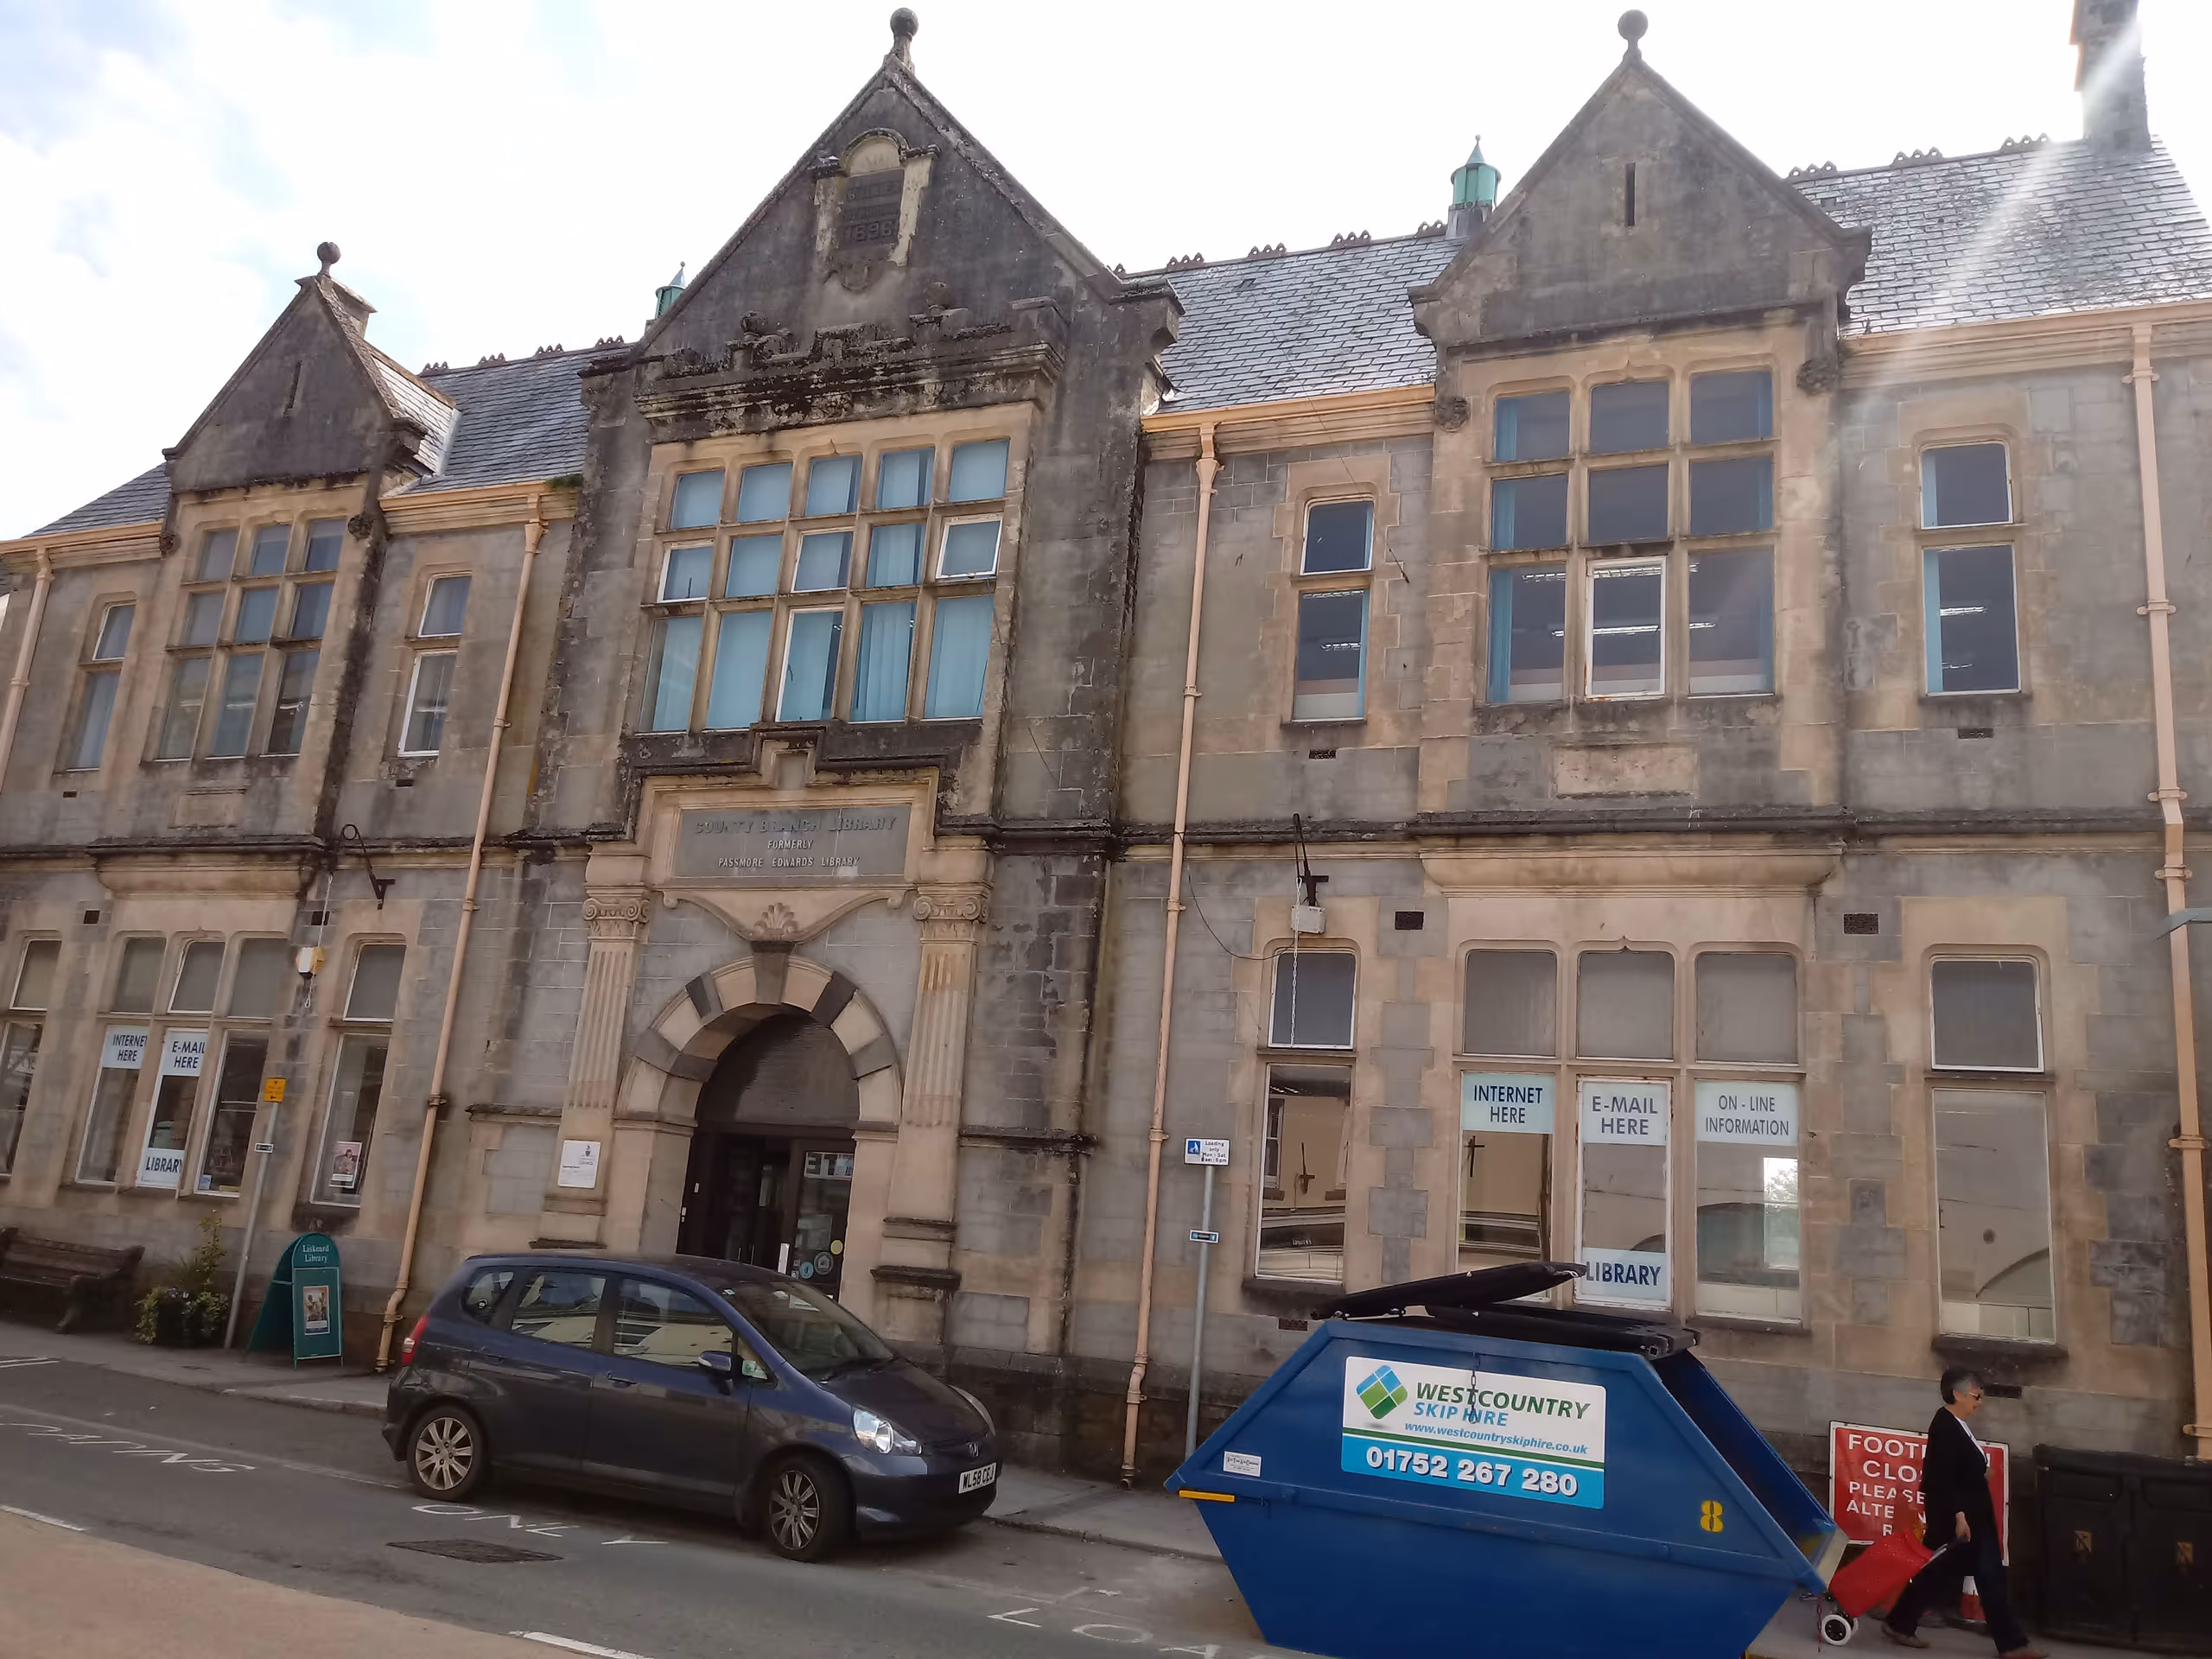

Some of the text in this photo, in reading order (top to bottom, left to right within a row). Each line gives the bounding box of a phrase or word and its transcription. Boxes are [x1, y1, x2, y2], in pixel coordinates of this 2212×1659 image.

[695, 817, 897, 835] COUNTY BRANCH LIBRARY
[767, 839, 814, 850] FORMERLY
[718, 856, 861, 868] PASSMORE EDWARDS LIBRARY
[118, 1050, 137, 1061] HERE
[172, 1041, 205, 1054] E-MAIL
[174, 1056, 199, 1069] HERE
[1473, 1084, 1543, 1104] INTERNET
[1592, 1096, 1658, 1115] E-MAIL
[1718, 1095, 1737, 1111] ON
[1750, 1096, 1776, 1112] LINE
[1490, 1106, 1526, 1124] HERE
[1601, 1117, 1649, 1135] HERE
[1705, 1116, 1789, 1136] INFORMATION
[305, 1254, 327, 1263] Library
[1586, 1262, 1661, 1286] LIBRARY
[1416, 1382, 1591, 1420] WESTCOUNTRY
[1414, 1402, 1509, 1427] SKIP HIRE
[1405, 1423, 1588, 1454] www.westcountryskiphire.co.uk
[1366, 1446, 1579, 1497] 01752 267 280
[1849, 1481, 1926, 1505] PLEASE
[1700, 1499, 1724, 1534] 8
